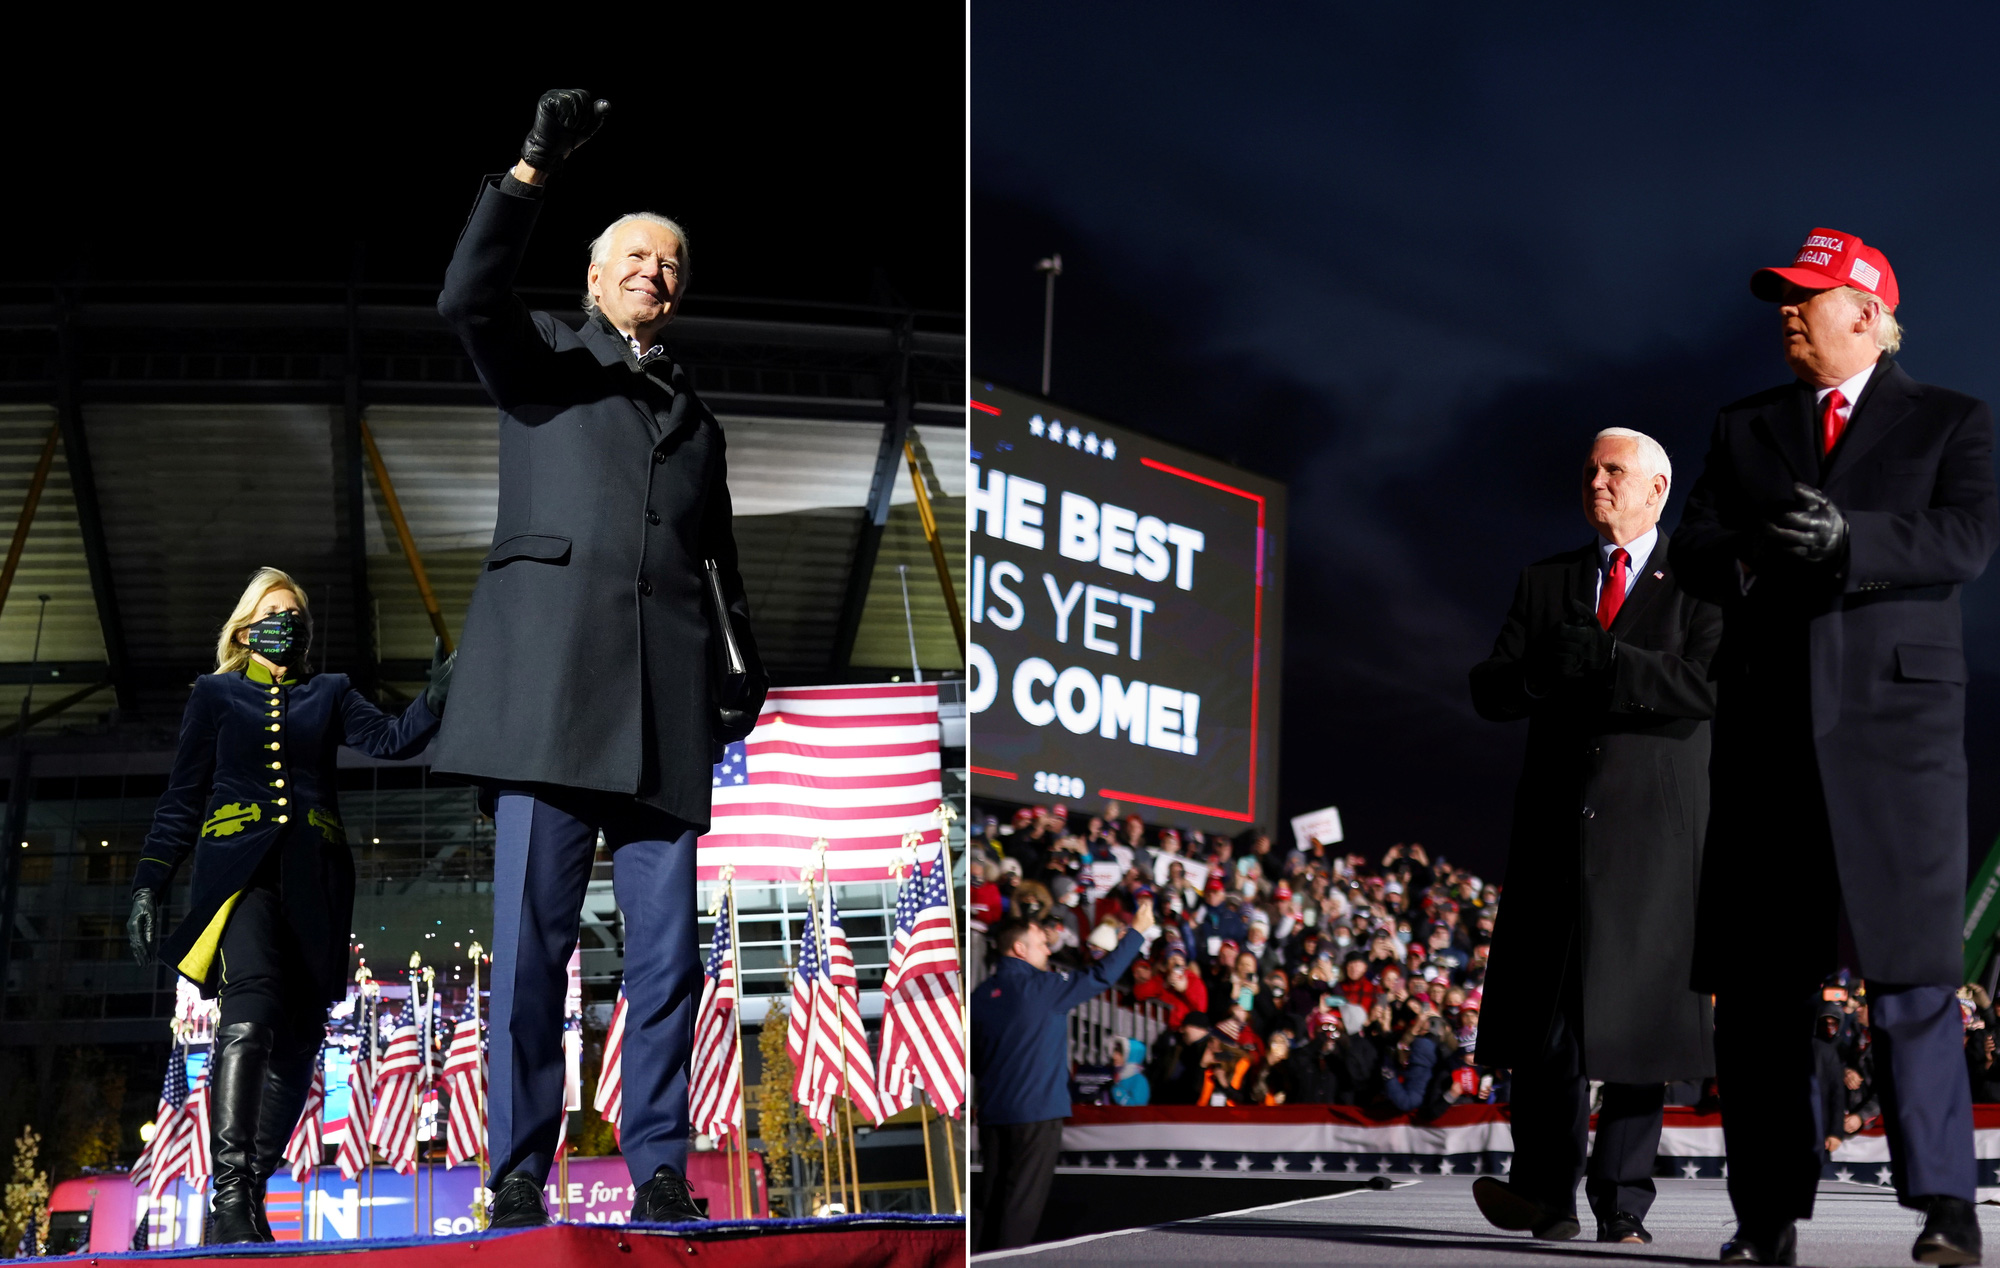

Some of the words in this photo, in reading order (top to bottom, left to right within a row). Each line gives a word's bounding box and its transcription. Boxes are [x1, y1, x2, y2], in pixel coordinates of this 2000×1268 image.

[1797, 250, 1832, 266] AGAIN
[1803, 235, 1843, 252] MERICA
[1059, 491, 1205, 591] BEST
[971, 555, 1025, 631] IS
[1042, 572, 1156, 661] YET
[1012, 656, 1201, 755] COME!
[1033, 771, 1086, 799] 2020
[585, 1181, 624, 1209] for
[136, 1188, 358, 1245] BIEN
